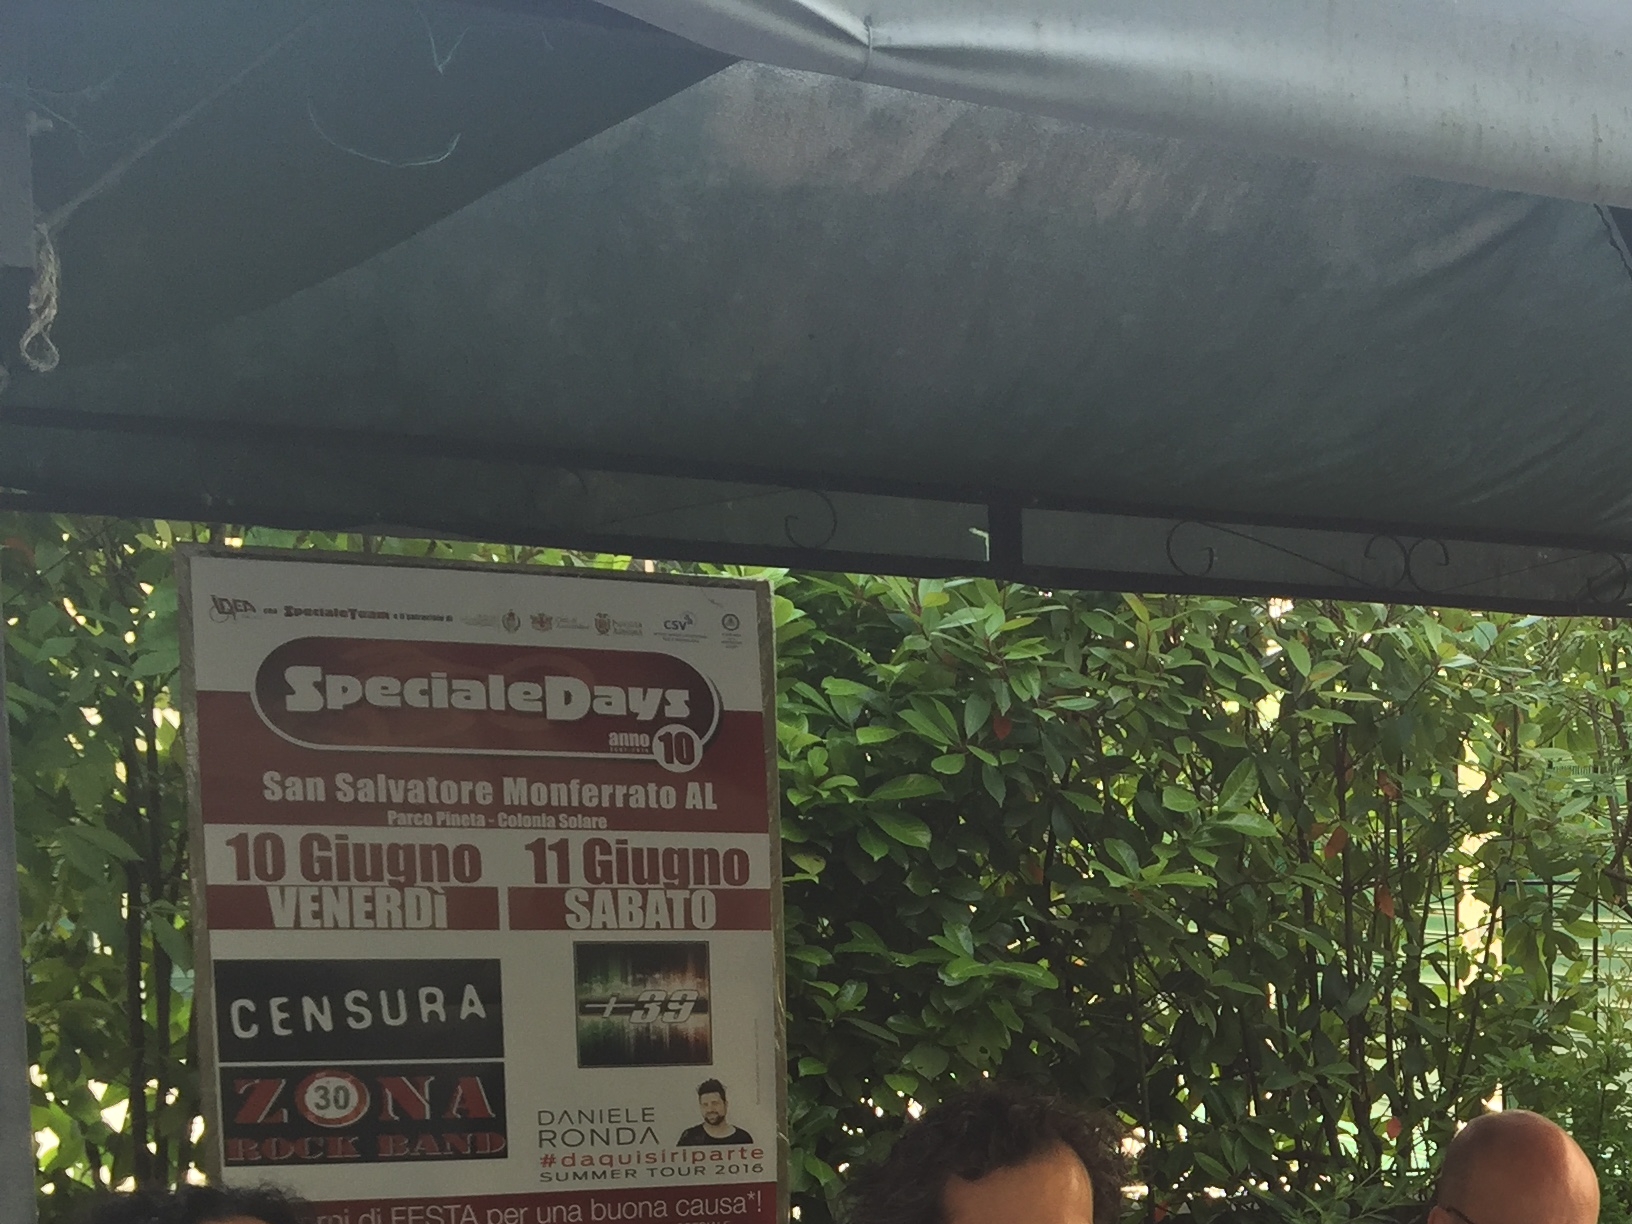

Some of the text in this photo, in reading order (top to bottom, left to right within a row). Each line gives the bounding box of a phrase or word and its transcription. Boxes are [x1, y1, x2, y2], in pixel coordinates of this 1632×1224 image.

[664, 616, 687, 631] CSV
[283, 665, 691, 722] SpecialeDays
[609, 731, 695, 766] anno 10
[262, 771, 718, 811] San Salvatore Monferrato AL
[387, 811, 433, 827] Parco
[437, 811, 486, 829] Pineta
[497, 813, 556, 830] Colonia
[558, 814, 608, 830] Solare
[226, 833, 483, 887] 10 Giugno
[525, 838, 751, 890] 11 Giugno
[564, 888, 717, 931] SABATO
[230, 983, 487, 1040] CENSURA
[584, 989, 699, 1025] +39
[305, 1081, 351, 1113] 30
[537, 1107, 656, 1127] DANIELE
[227, 1130, 507, 1163] ROCK BAND
[538, 1126, 660, 1149] RONDA
[539, 1147, 765, 1170] #daquisiriparte
[540, 1162, 764, 1183] SUMMER TOUR 2016
[536, 1204, 583, 1224] una
[590, 1198, 667, 1222] buona
